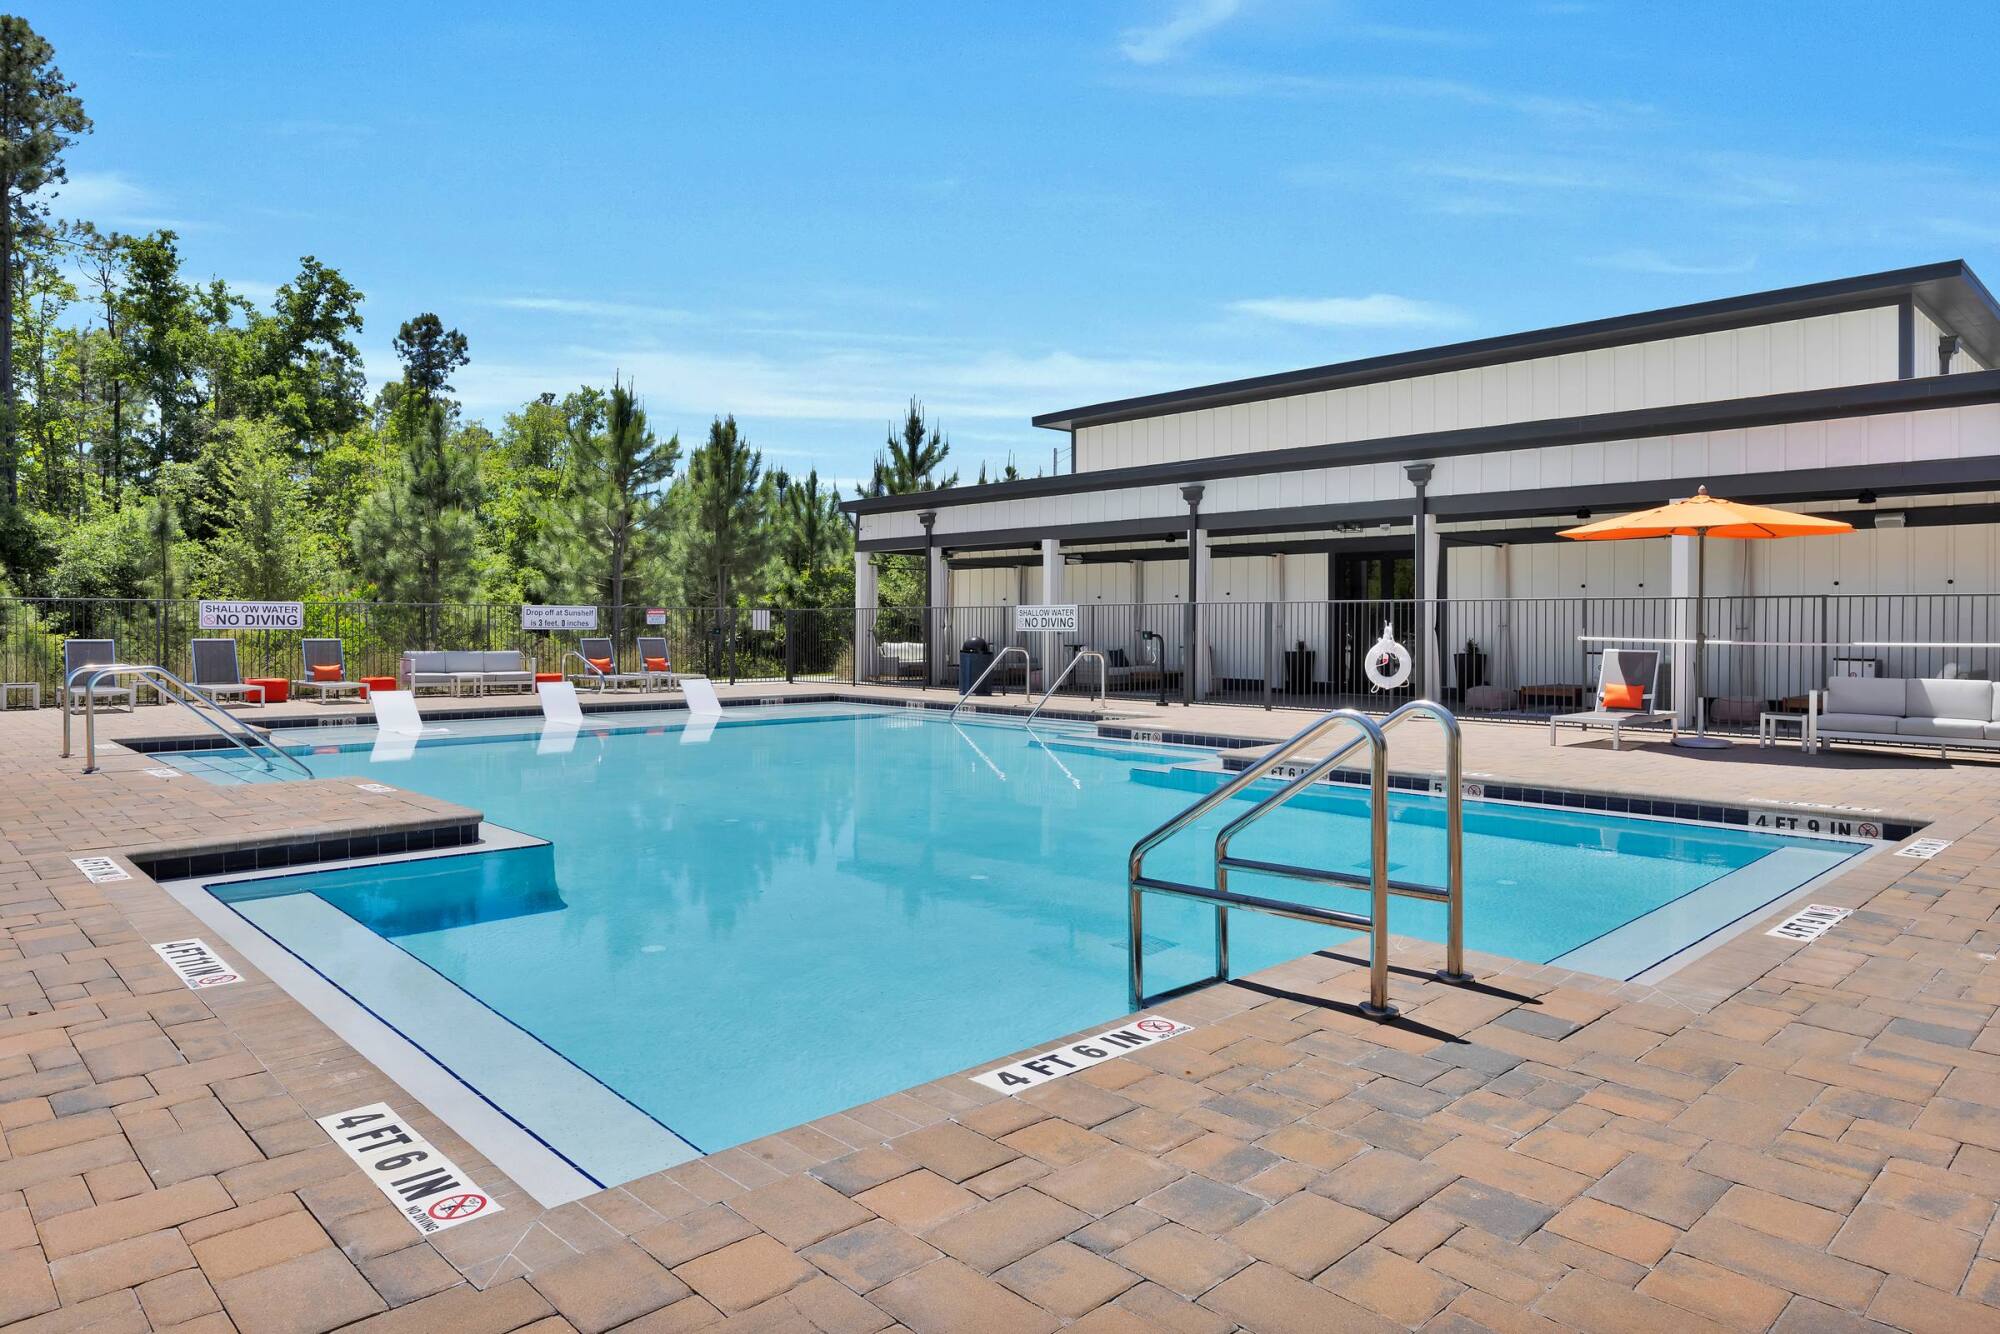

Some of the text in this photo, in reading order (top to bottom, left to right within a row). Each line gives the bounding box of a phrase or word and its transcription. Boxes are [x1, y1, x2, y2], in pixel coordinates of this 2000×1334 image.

[205, 605, 259, 613] SHALLOW
[216, 614, 298, 625] NO DIVING
[1025, 617, 1074, 627] NO DIVING
[1134, 732, 1151, 741] 4 FT
[1755, 815, 1851, 836] 4 FT 9 IN
[1802, 911, 1838, 921] IN
[1777, 930, 1808, 938] 4
[1782, 922, 1819, 934] FT
[166, 947, 207, 959] FT
[183, 964, 225, 977] IN
[997, 1030, 1151, 1086] 4 FT 6 IN
[335, 1113, 461, 1202] 4 FT 6 IN
[405, 1205, 439, 1232] NO DIVING
